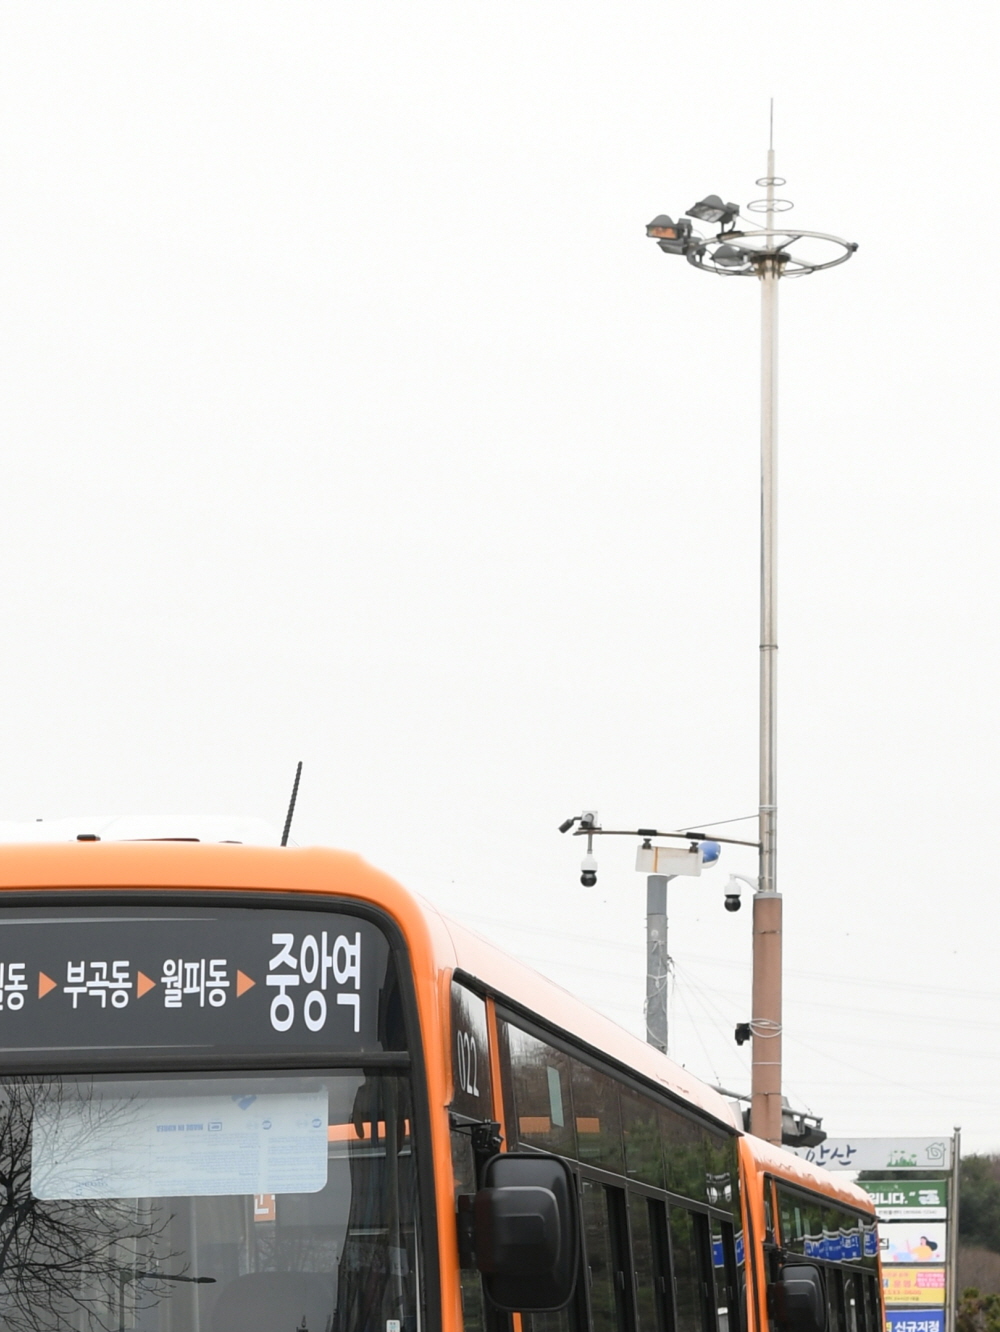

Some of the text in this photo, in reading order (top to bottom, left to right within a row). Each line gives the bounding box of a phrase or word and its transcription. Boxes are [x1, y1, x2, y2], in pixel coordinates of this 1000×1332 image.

[63, 960, 133, 1009] 부곡동
[160, 958, 230, 1008] 월피동
[265, 931, 362, 1034] 중앙역
[457, 1029, 480, 1098] 022
